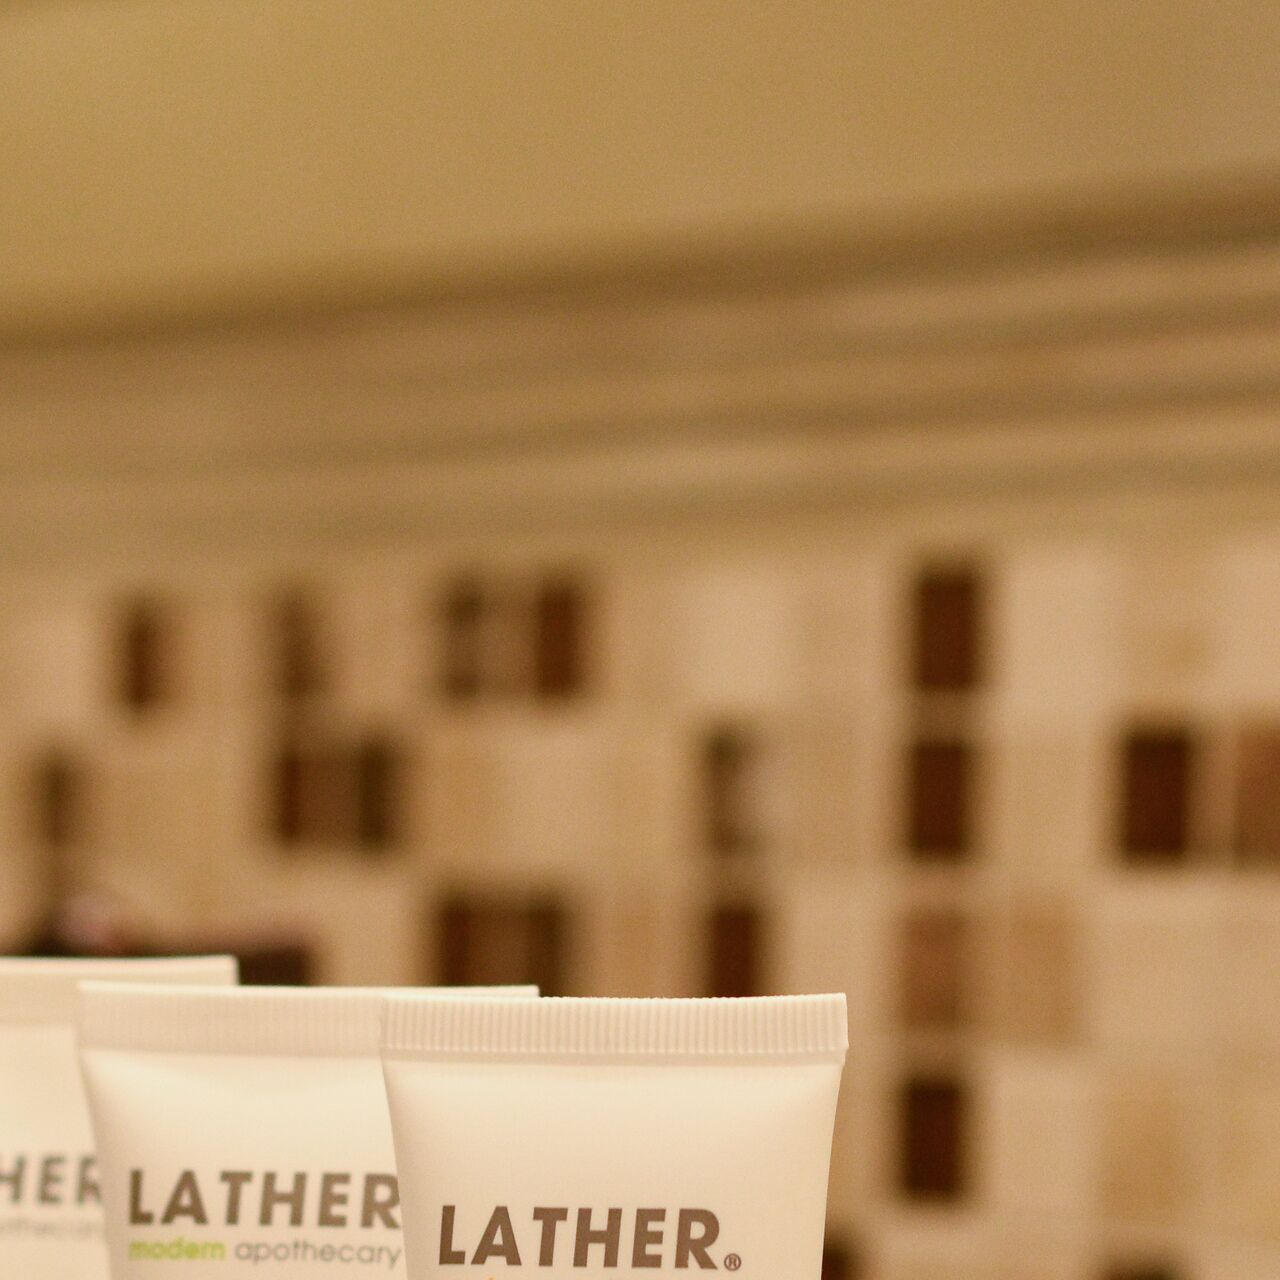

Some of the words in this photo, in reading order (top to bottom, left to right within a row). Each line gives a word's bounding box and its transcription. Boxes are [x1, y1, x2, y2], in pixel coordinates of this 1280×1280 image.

[128, 1168, 402, 1230] LATHER
[129, 1237, 227, 1260] modern
[234, 1239, 403, 1270] apothecary
